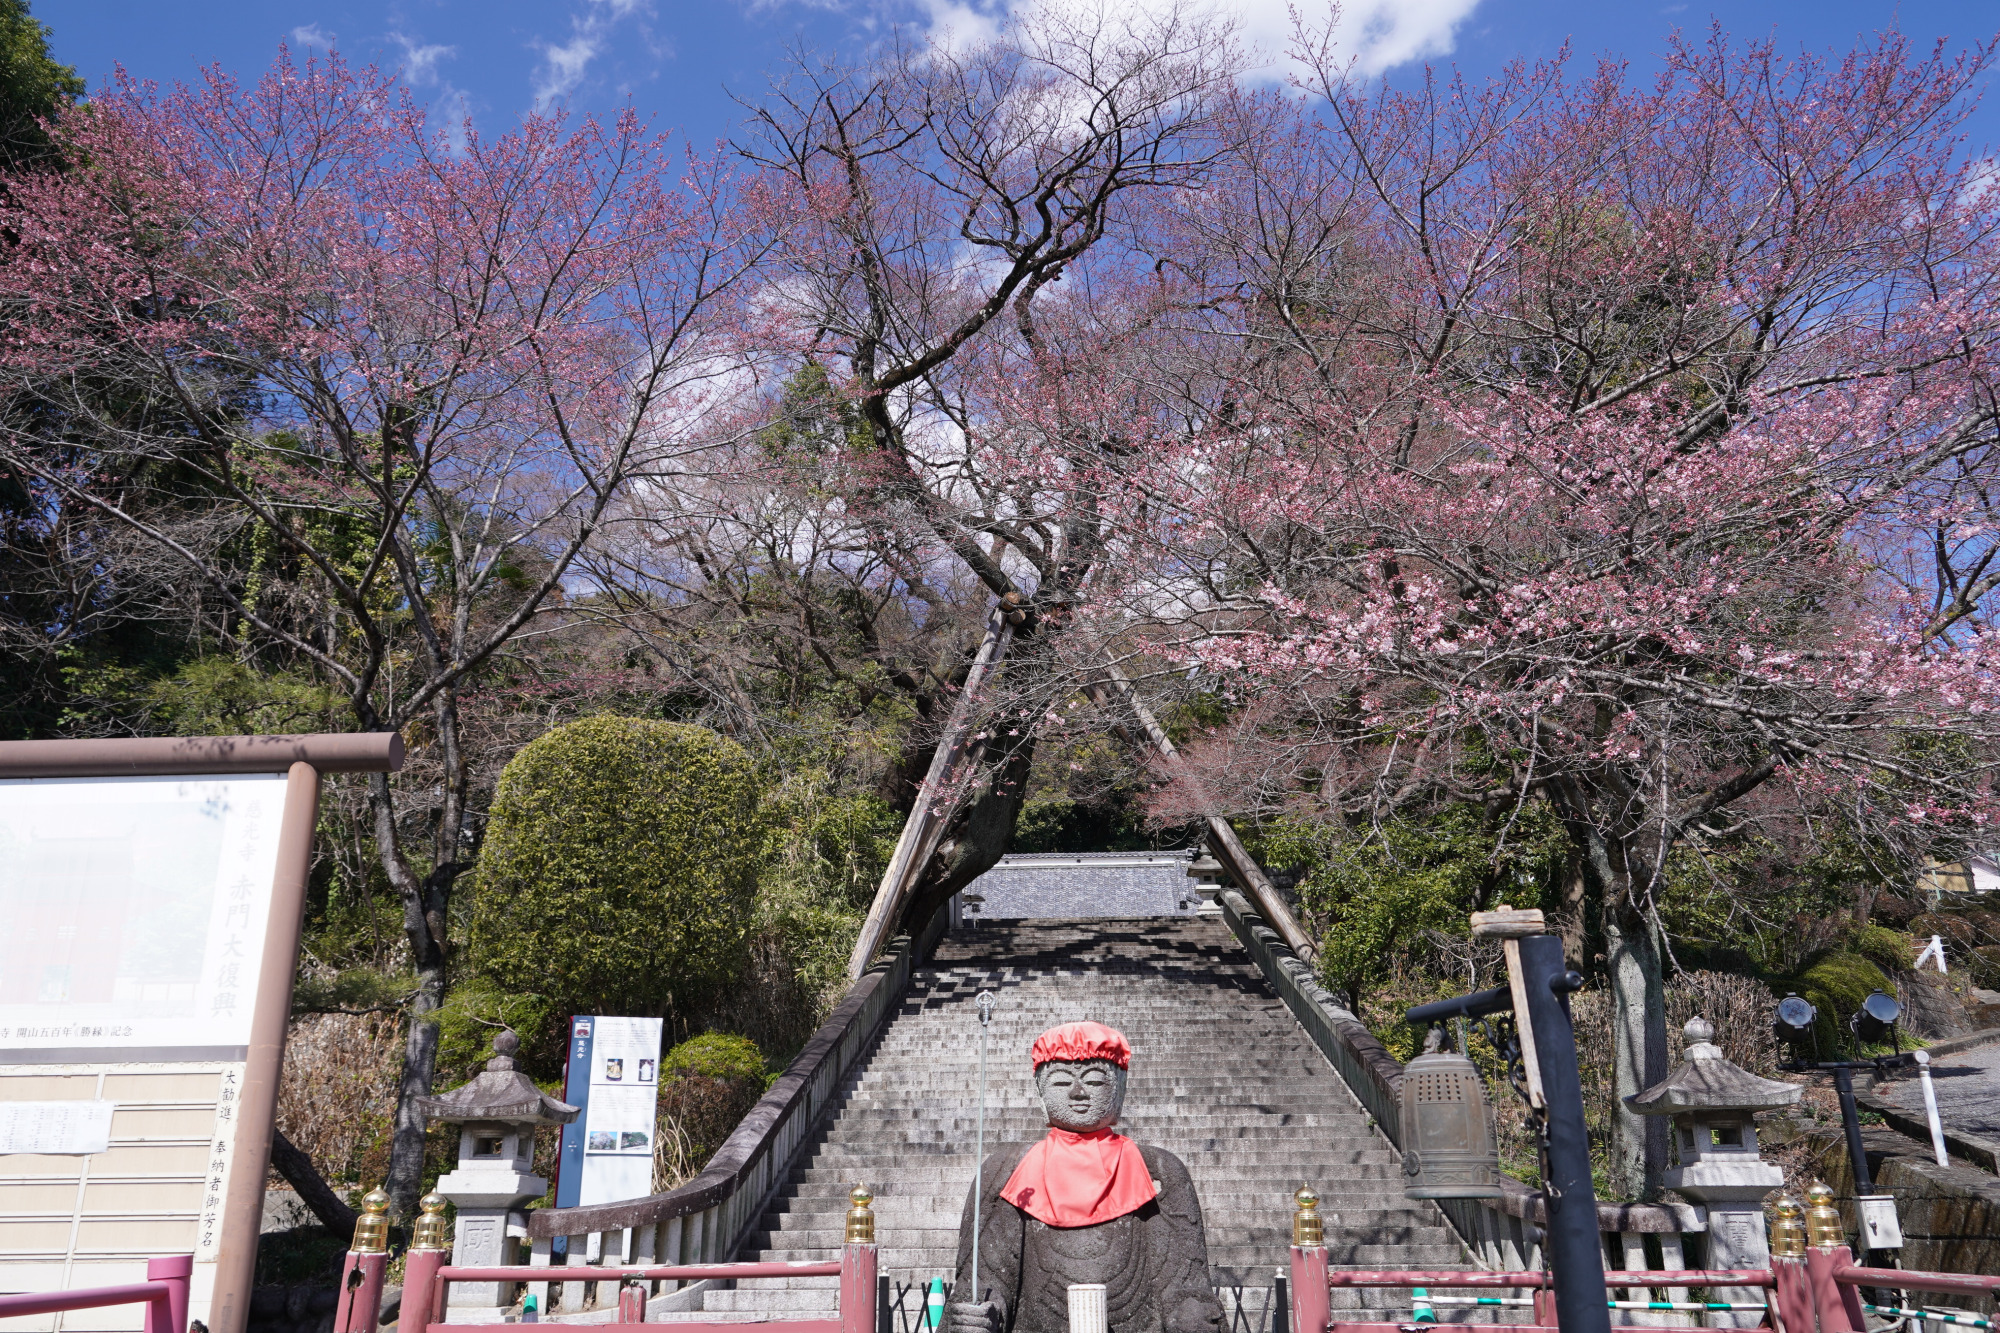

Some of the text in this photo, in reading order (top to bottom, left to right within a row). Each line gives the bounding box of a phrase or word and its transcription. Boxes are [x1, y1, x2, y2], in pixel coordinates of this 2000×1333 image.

[210, 800, 263, 1018] 慈光寺 赤門大復興
[201, 1140, 226, 1247] 奉納者御芳名
